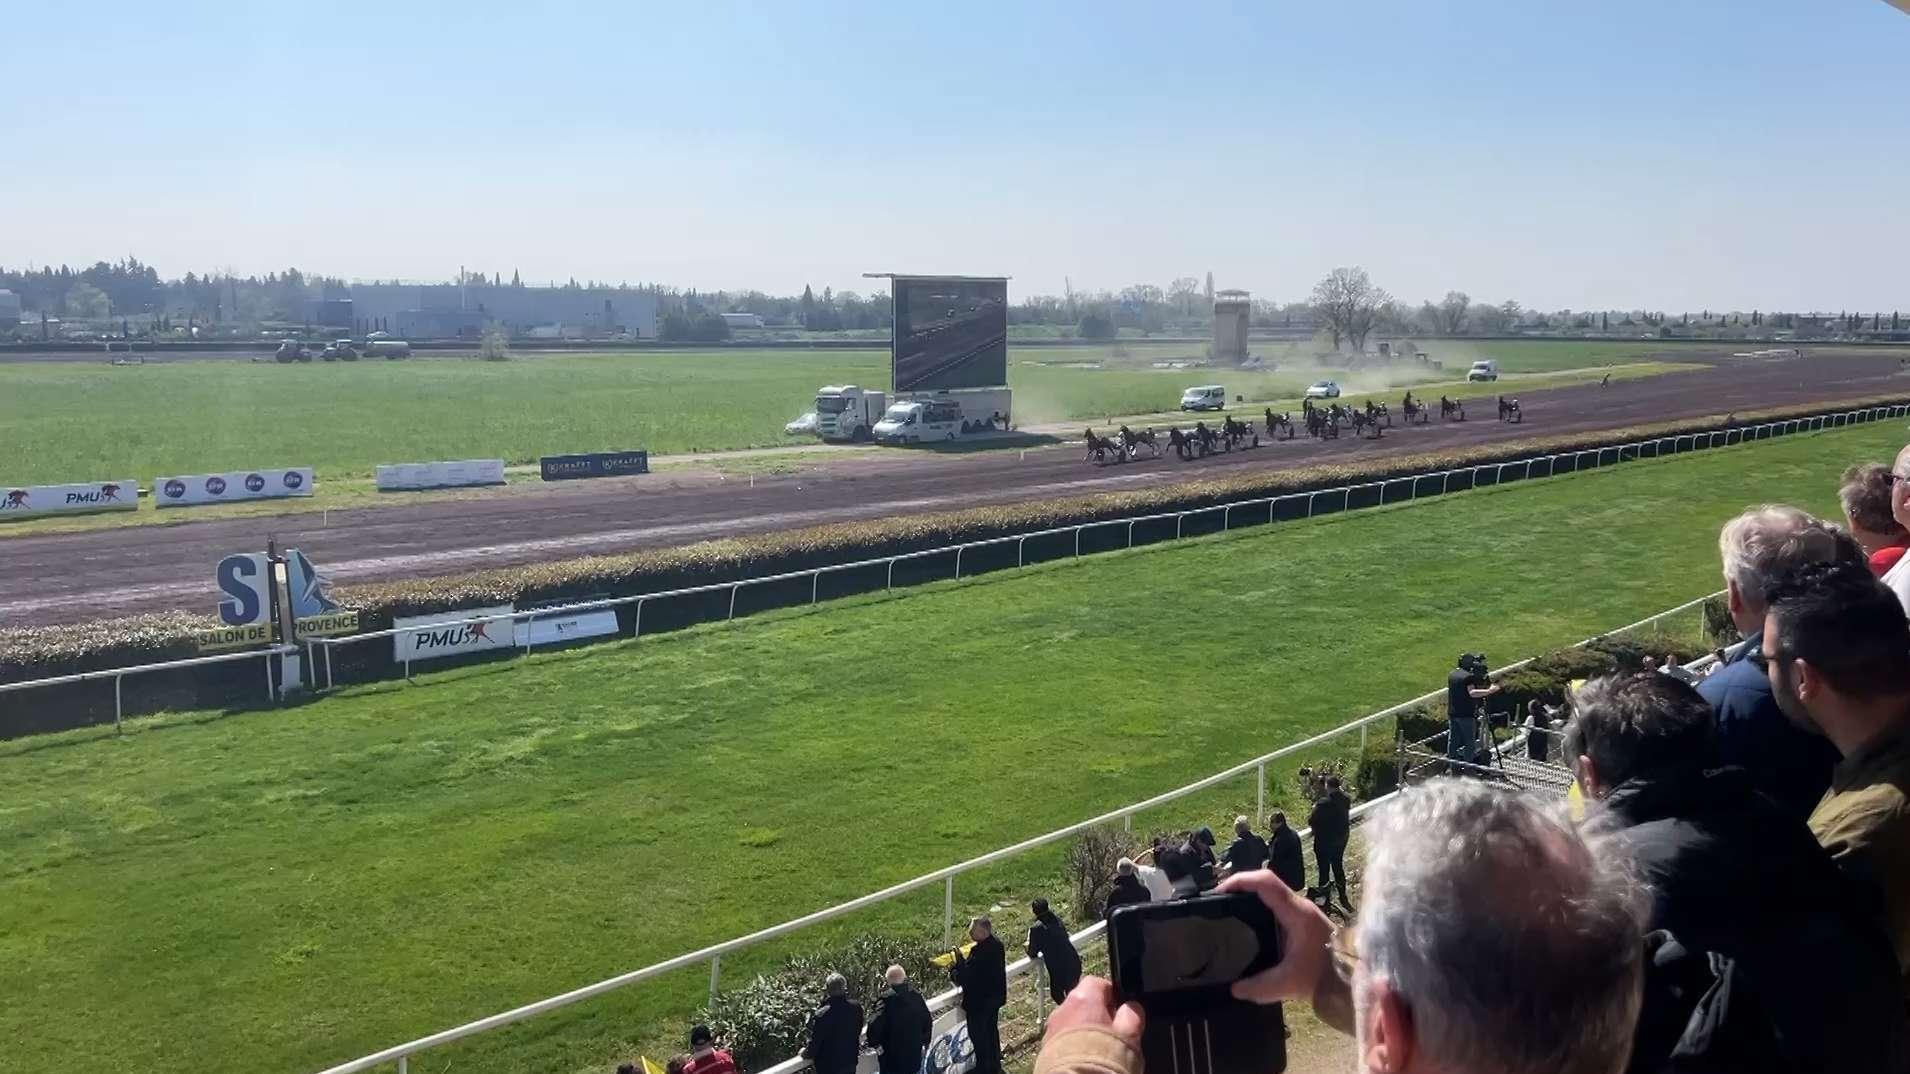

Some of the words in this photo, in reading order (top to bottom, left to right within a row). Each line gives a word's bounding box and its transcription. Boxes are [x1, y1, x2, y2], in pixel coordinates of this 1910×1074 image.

[65, 491, 101, 504] PMU
[217, 555, 260, 625] S
[200, 630, 245, 646] SALON
[249, 627, 266, 640] DE
[415, 627, 464, 650] PMU
